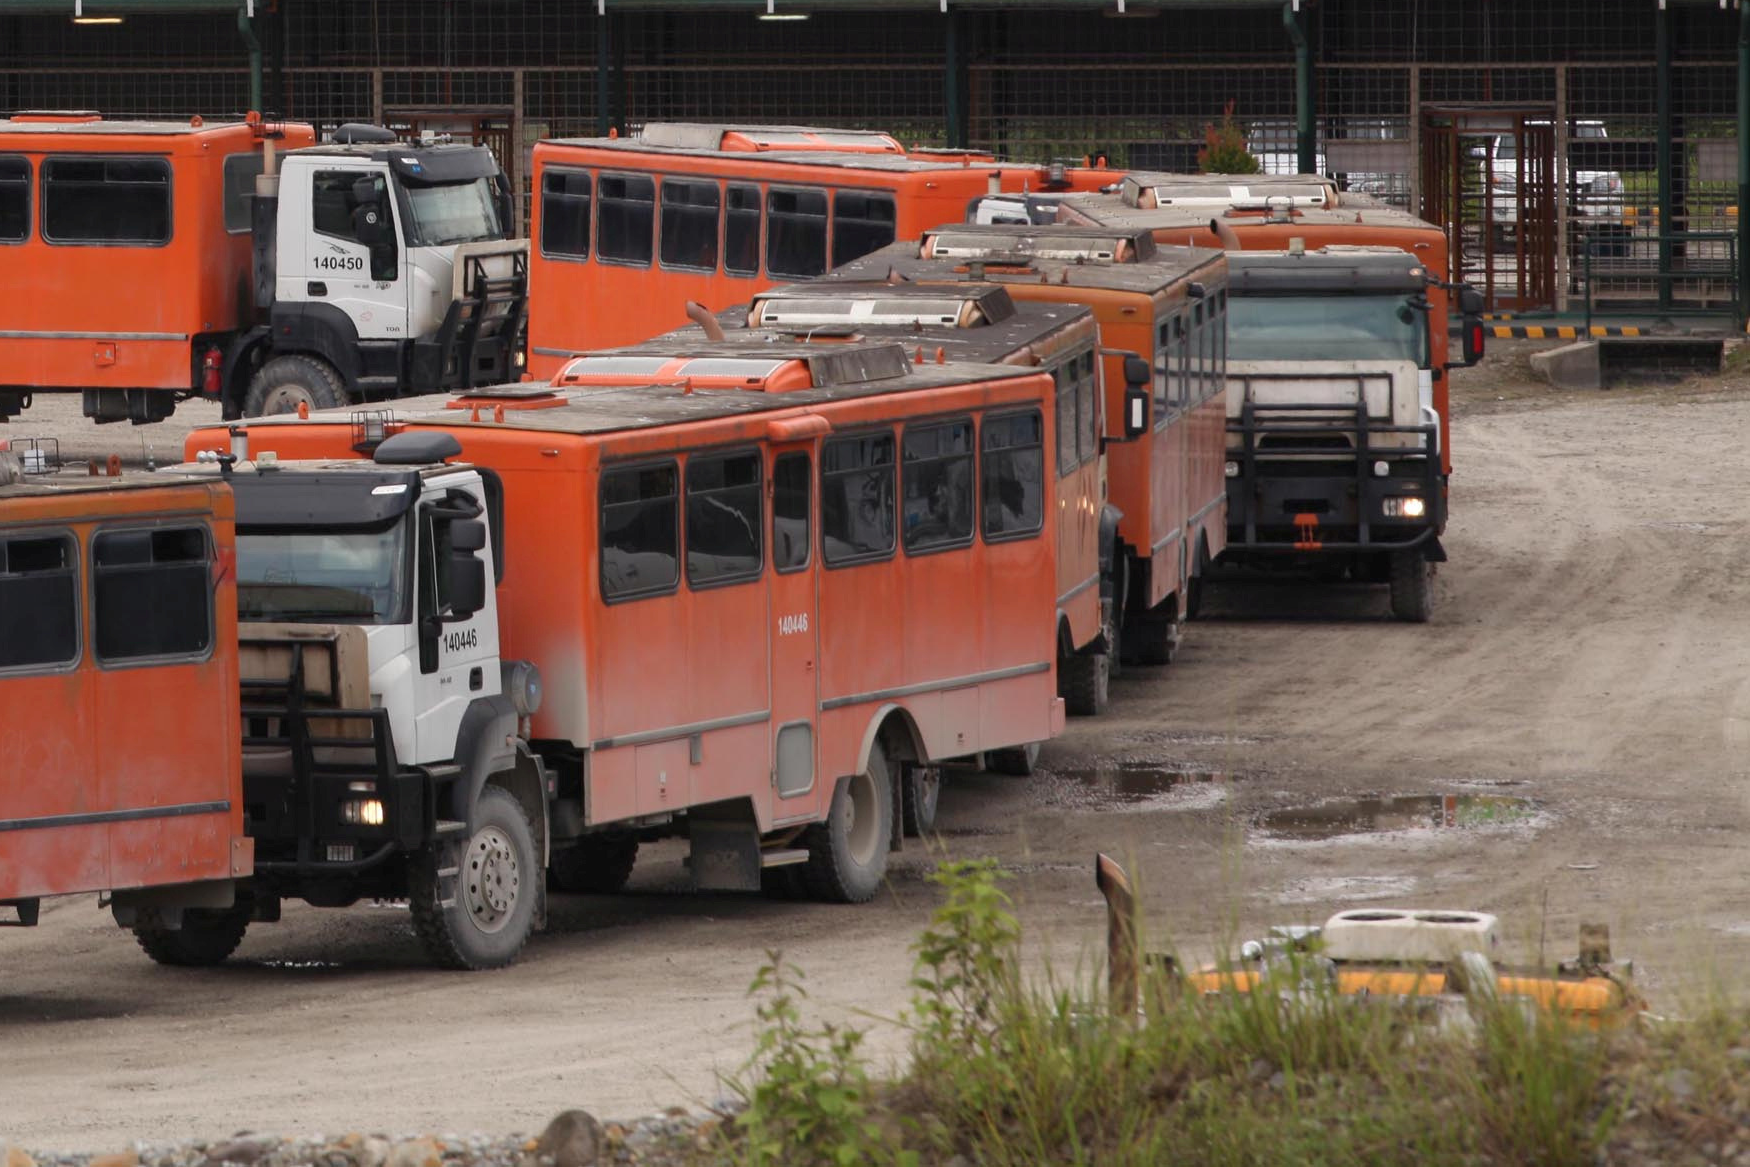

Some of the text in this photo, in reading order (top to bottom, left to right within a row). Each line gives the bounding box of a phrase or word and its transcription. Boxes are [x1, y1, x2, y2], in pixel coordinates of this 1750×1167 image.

[313, 257, 363, 270] 140450
[778, 613, 808, 636] 140446
[443, 628, 478, 653] 140446
